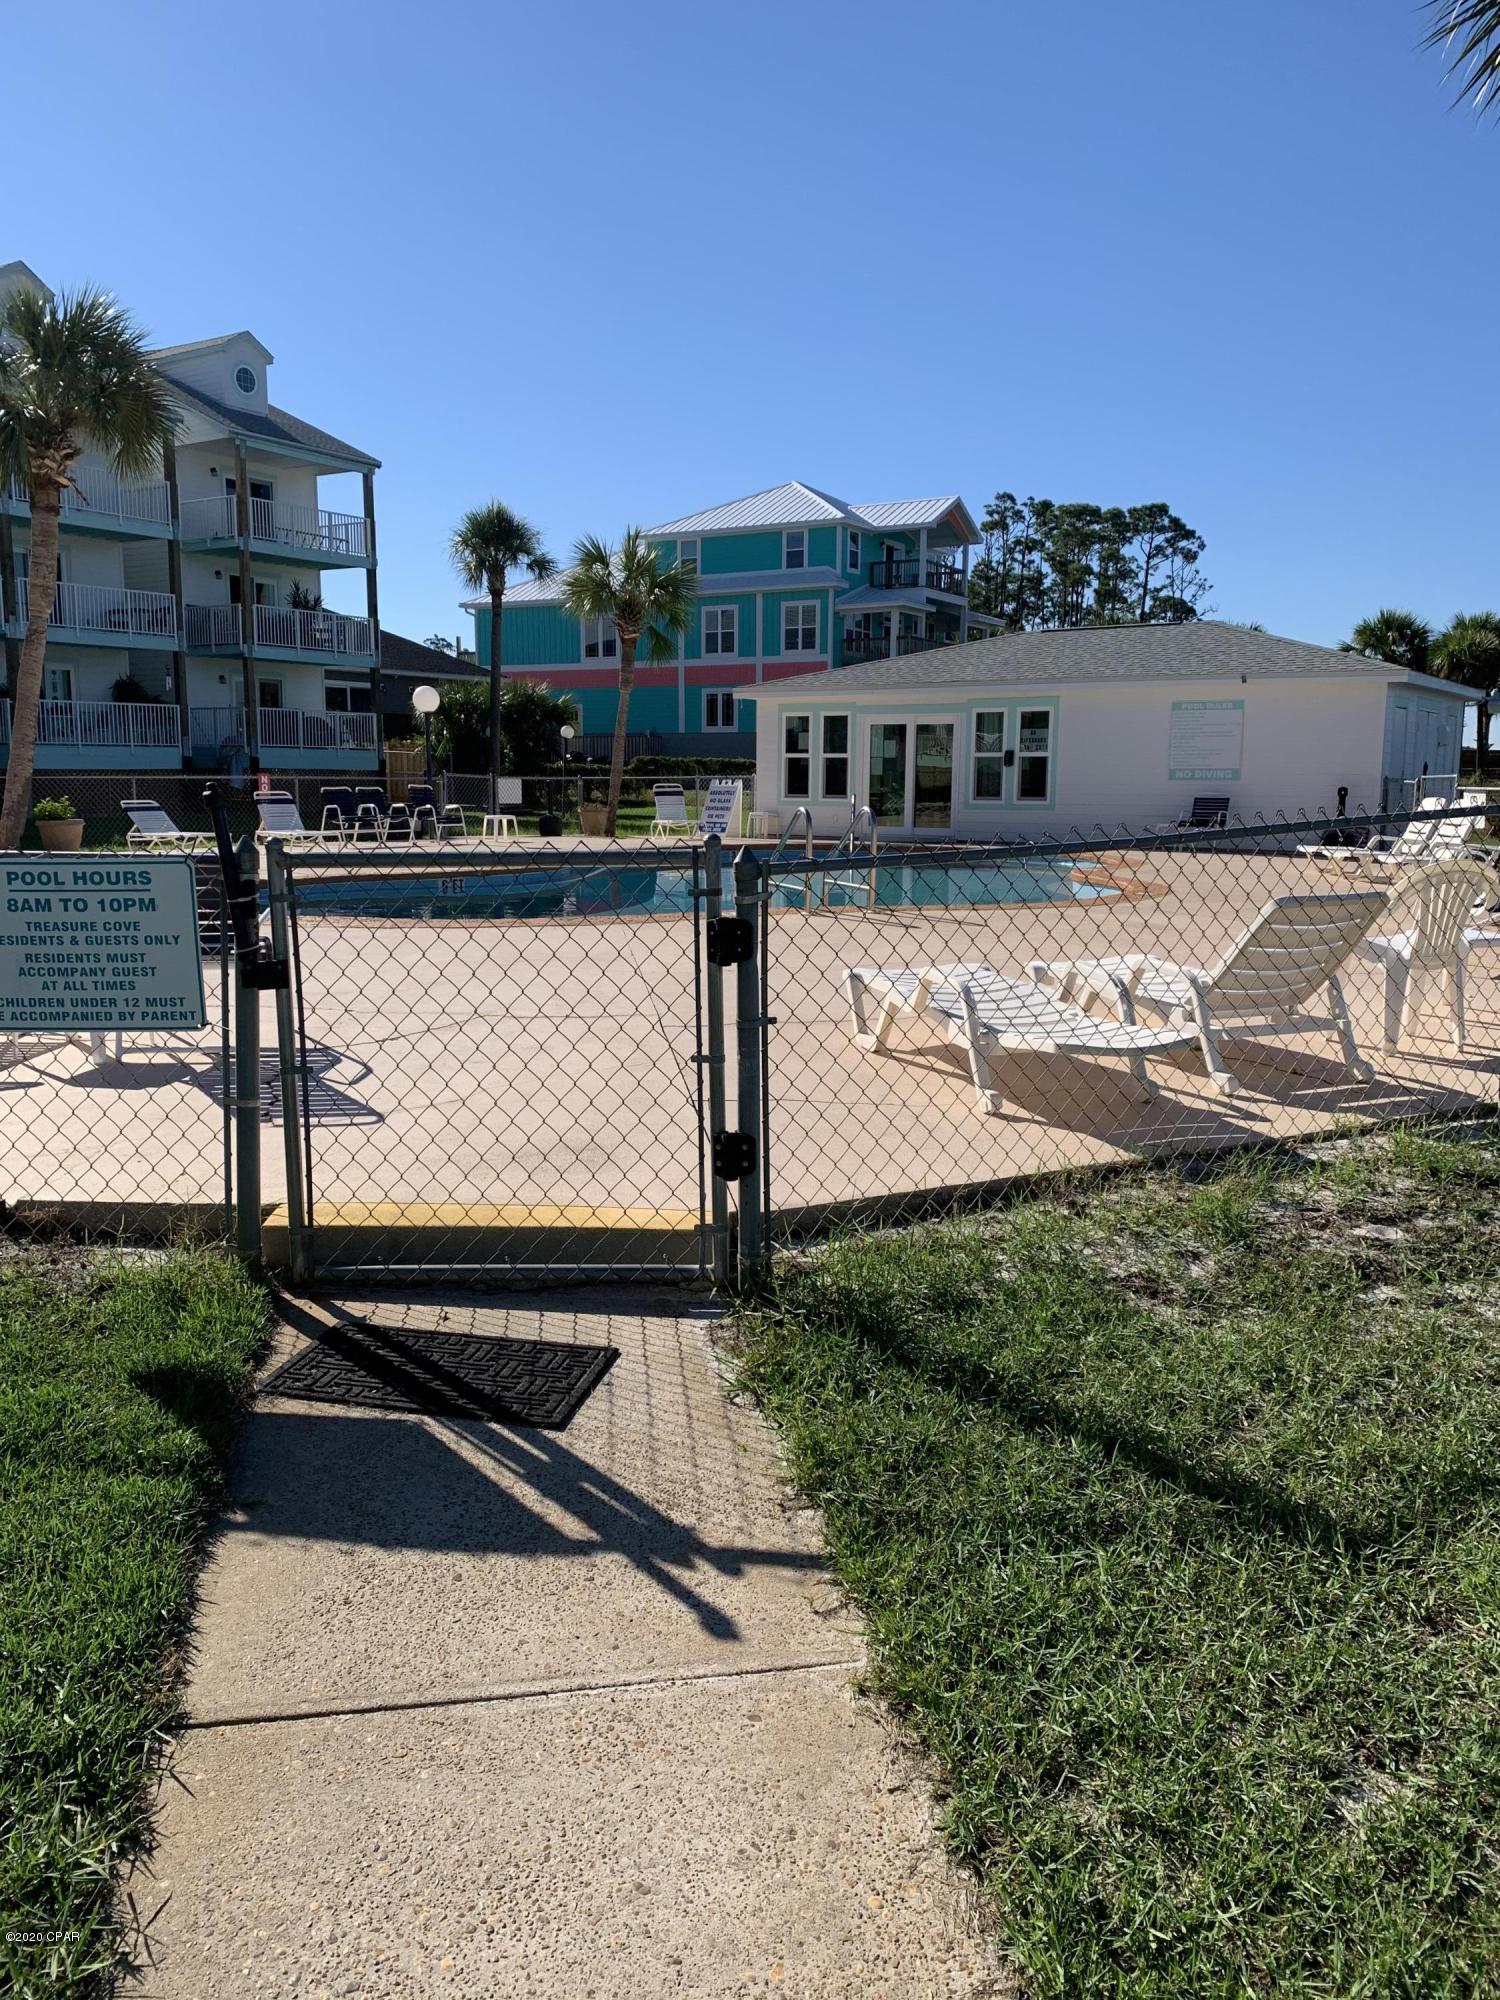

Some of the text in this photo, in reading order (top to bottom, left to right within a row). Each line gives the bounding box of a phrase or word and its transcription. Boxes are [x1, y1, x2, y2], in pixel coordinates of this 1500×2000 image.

[1175, 769, 1232, 779] NO DIVING
[6, 870, 153, 886] POOL HOURS
[7, 897, 157, 912] 8AM TO 10PM
[25, 921, 141, 932] TREASURE COVE
[0, 934, 181, 946] ESIDENTS & GUESTS ONLY
[25, 953, 147, 963] RESIDENTS MUST
[18, 966, 157, 977] ACCOMPANY GUEST
[41, 980, 136, 991] AT ALL TIMES
[70, 997, 118, 1008] UNDER
[125, 997, 140, 1008] 12
[145, 997, 186, 1007] MUST
[10, 1011, 113, 1022] ACCOMPANIED
[118, 1011, 136, 1021] BY
[141, 1010, 197, 1021] PARENT
